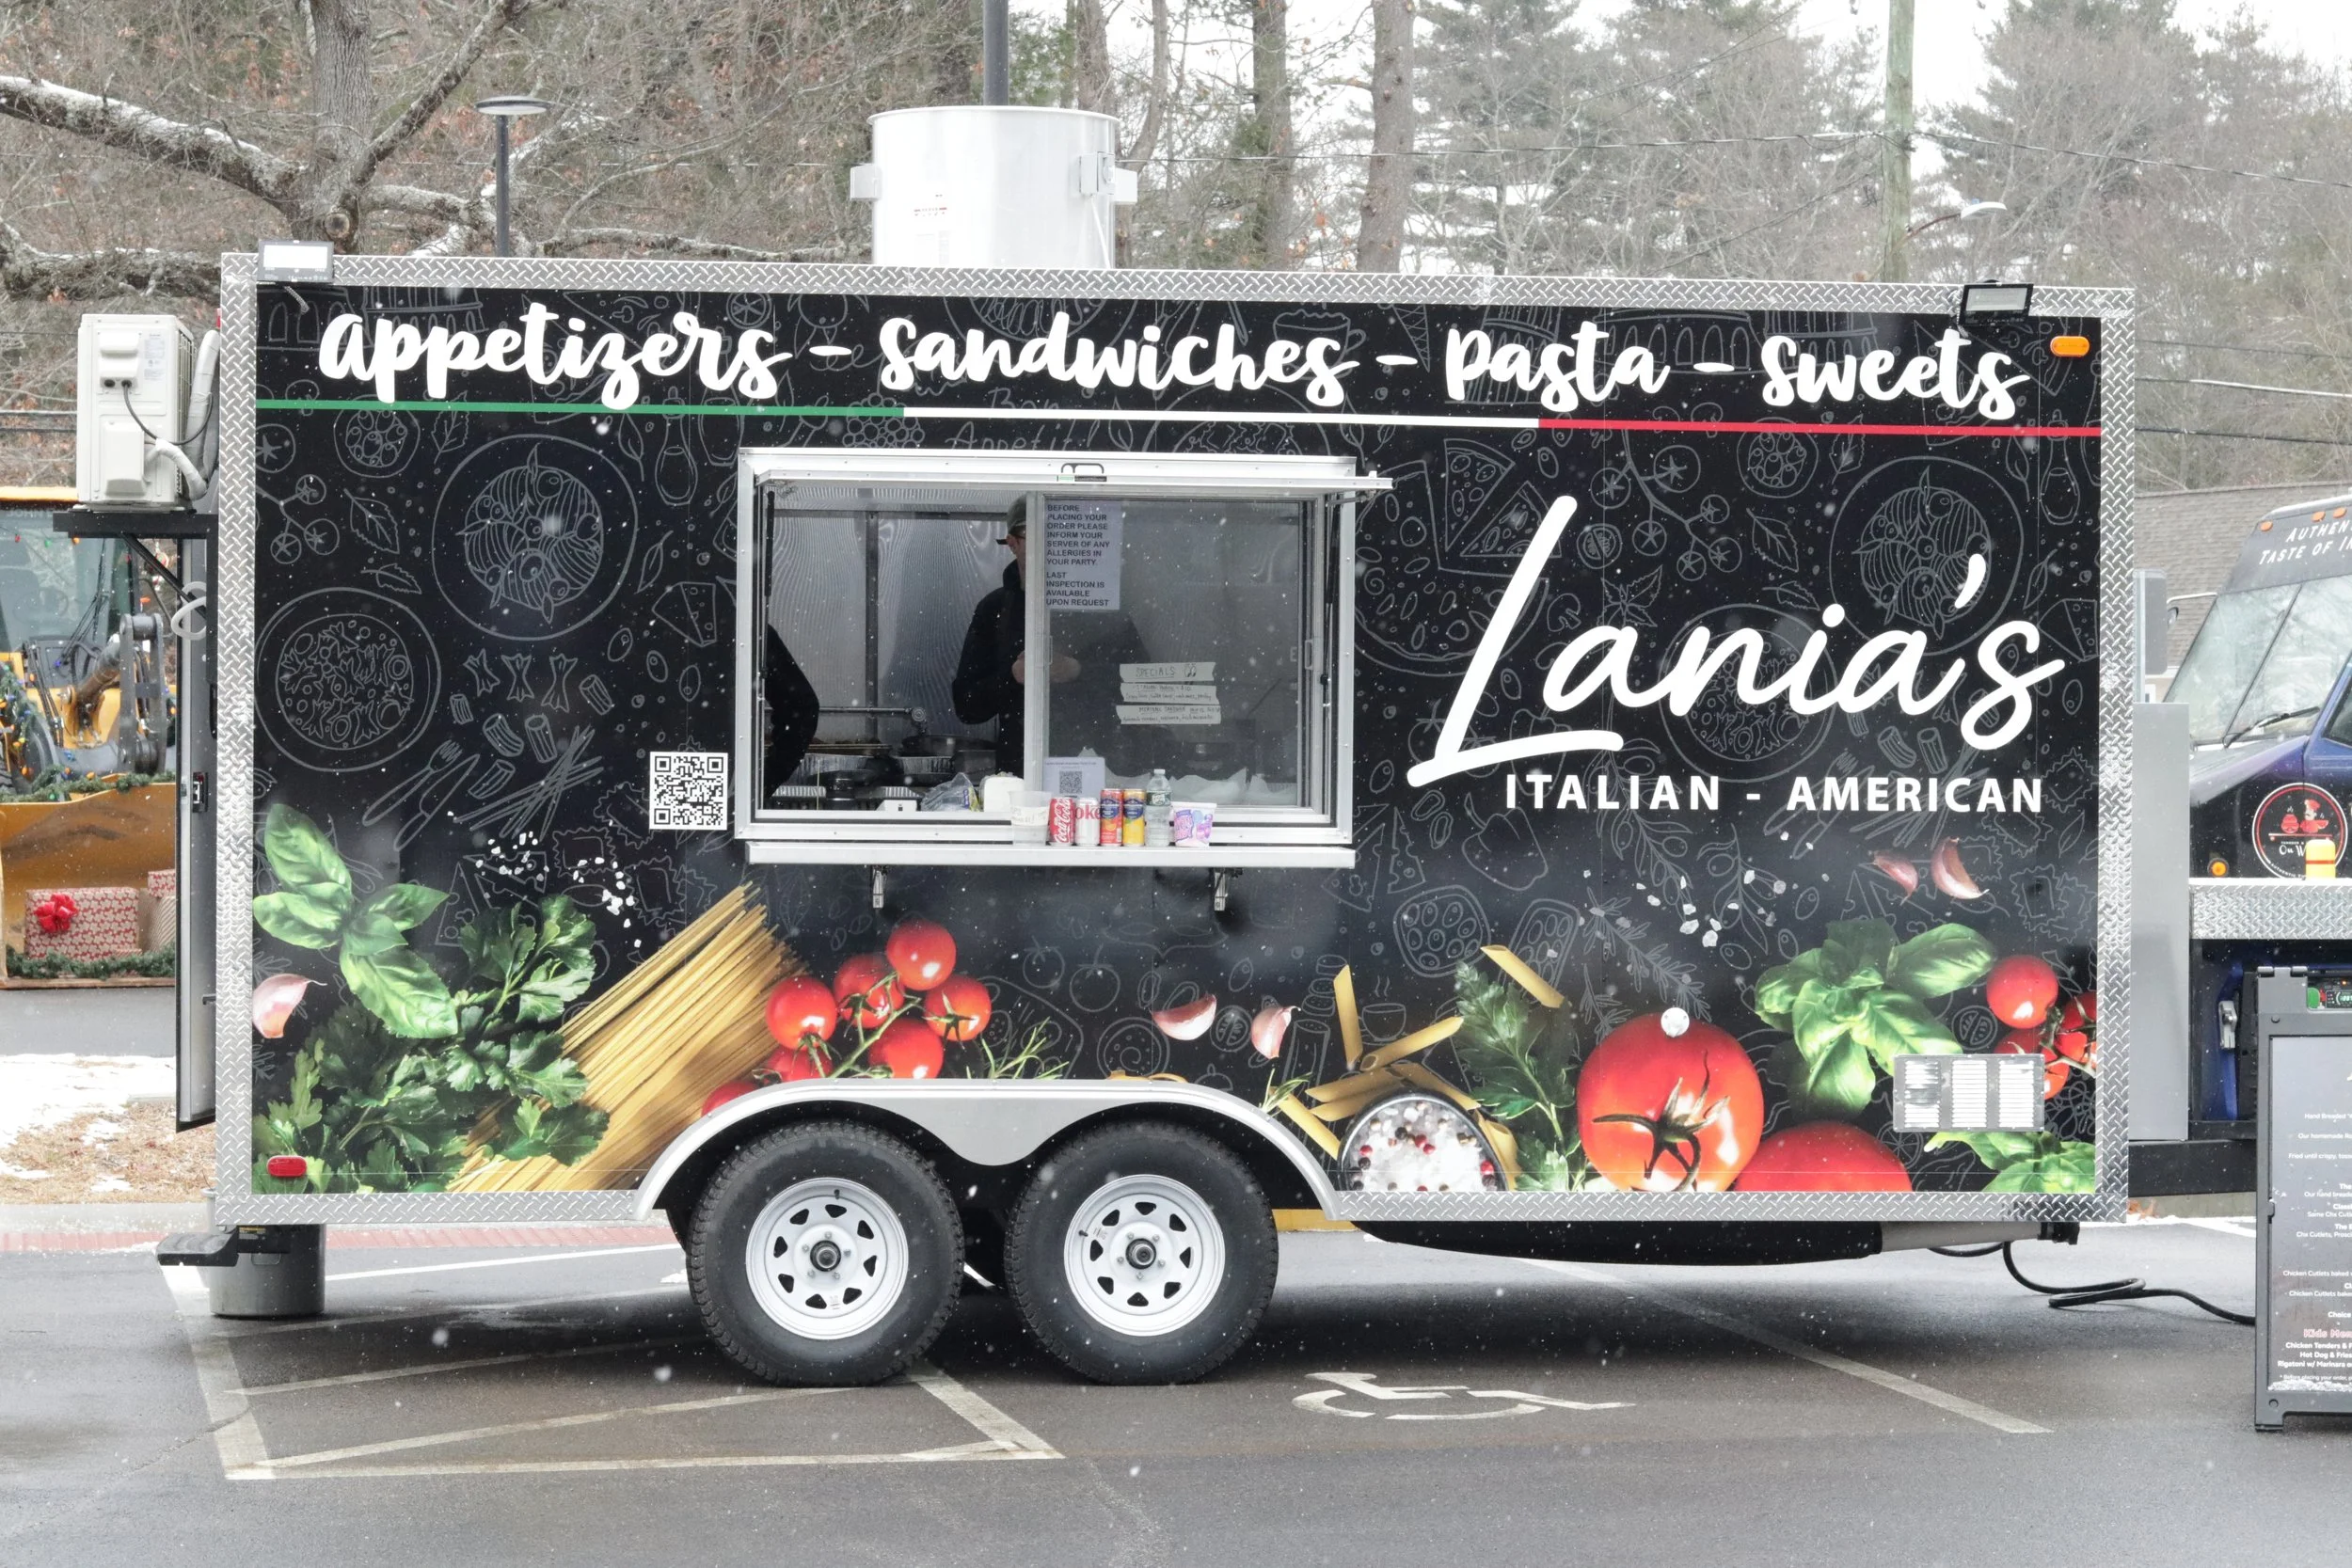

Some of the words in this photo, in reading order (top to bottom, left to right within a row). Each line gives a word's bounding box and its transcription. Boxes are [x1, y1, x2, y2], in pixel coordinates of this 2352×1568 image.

[1046, 522, 1076, 531] ORDER
[1077, 522, 1108, 531] PLEASE
[1046, 540, 1080, 548] SERVER
[1081, 540, 1092, 548] OF
[1093, 540, 1110, 548] ANY
[2259, 545, 2307, 565] TASTE
[2312, 540, 2334, 556] OF
[1046, 558, 1070, 566] YOUR
[1046, 571, 1068, 579] LAST
[1046, 589, 1090, 597] AVAILABLE
[1045, 598, 1070, 607] UPON
[1071, 598, 1109, 607] REQUEST
[1406, 495, 2064, 787] Lania's
[1136, 666, 1175, 678] SPECIALS
[1506, 774, 1720, 810] ITALIAN
[1787, 776, 2042, 813] AMERICAN
[1075, 804, 1101, 820] oke
[2303, 1328, 2328, 1338] Kids
